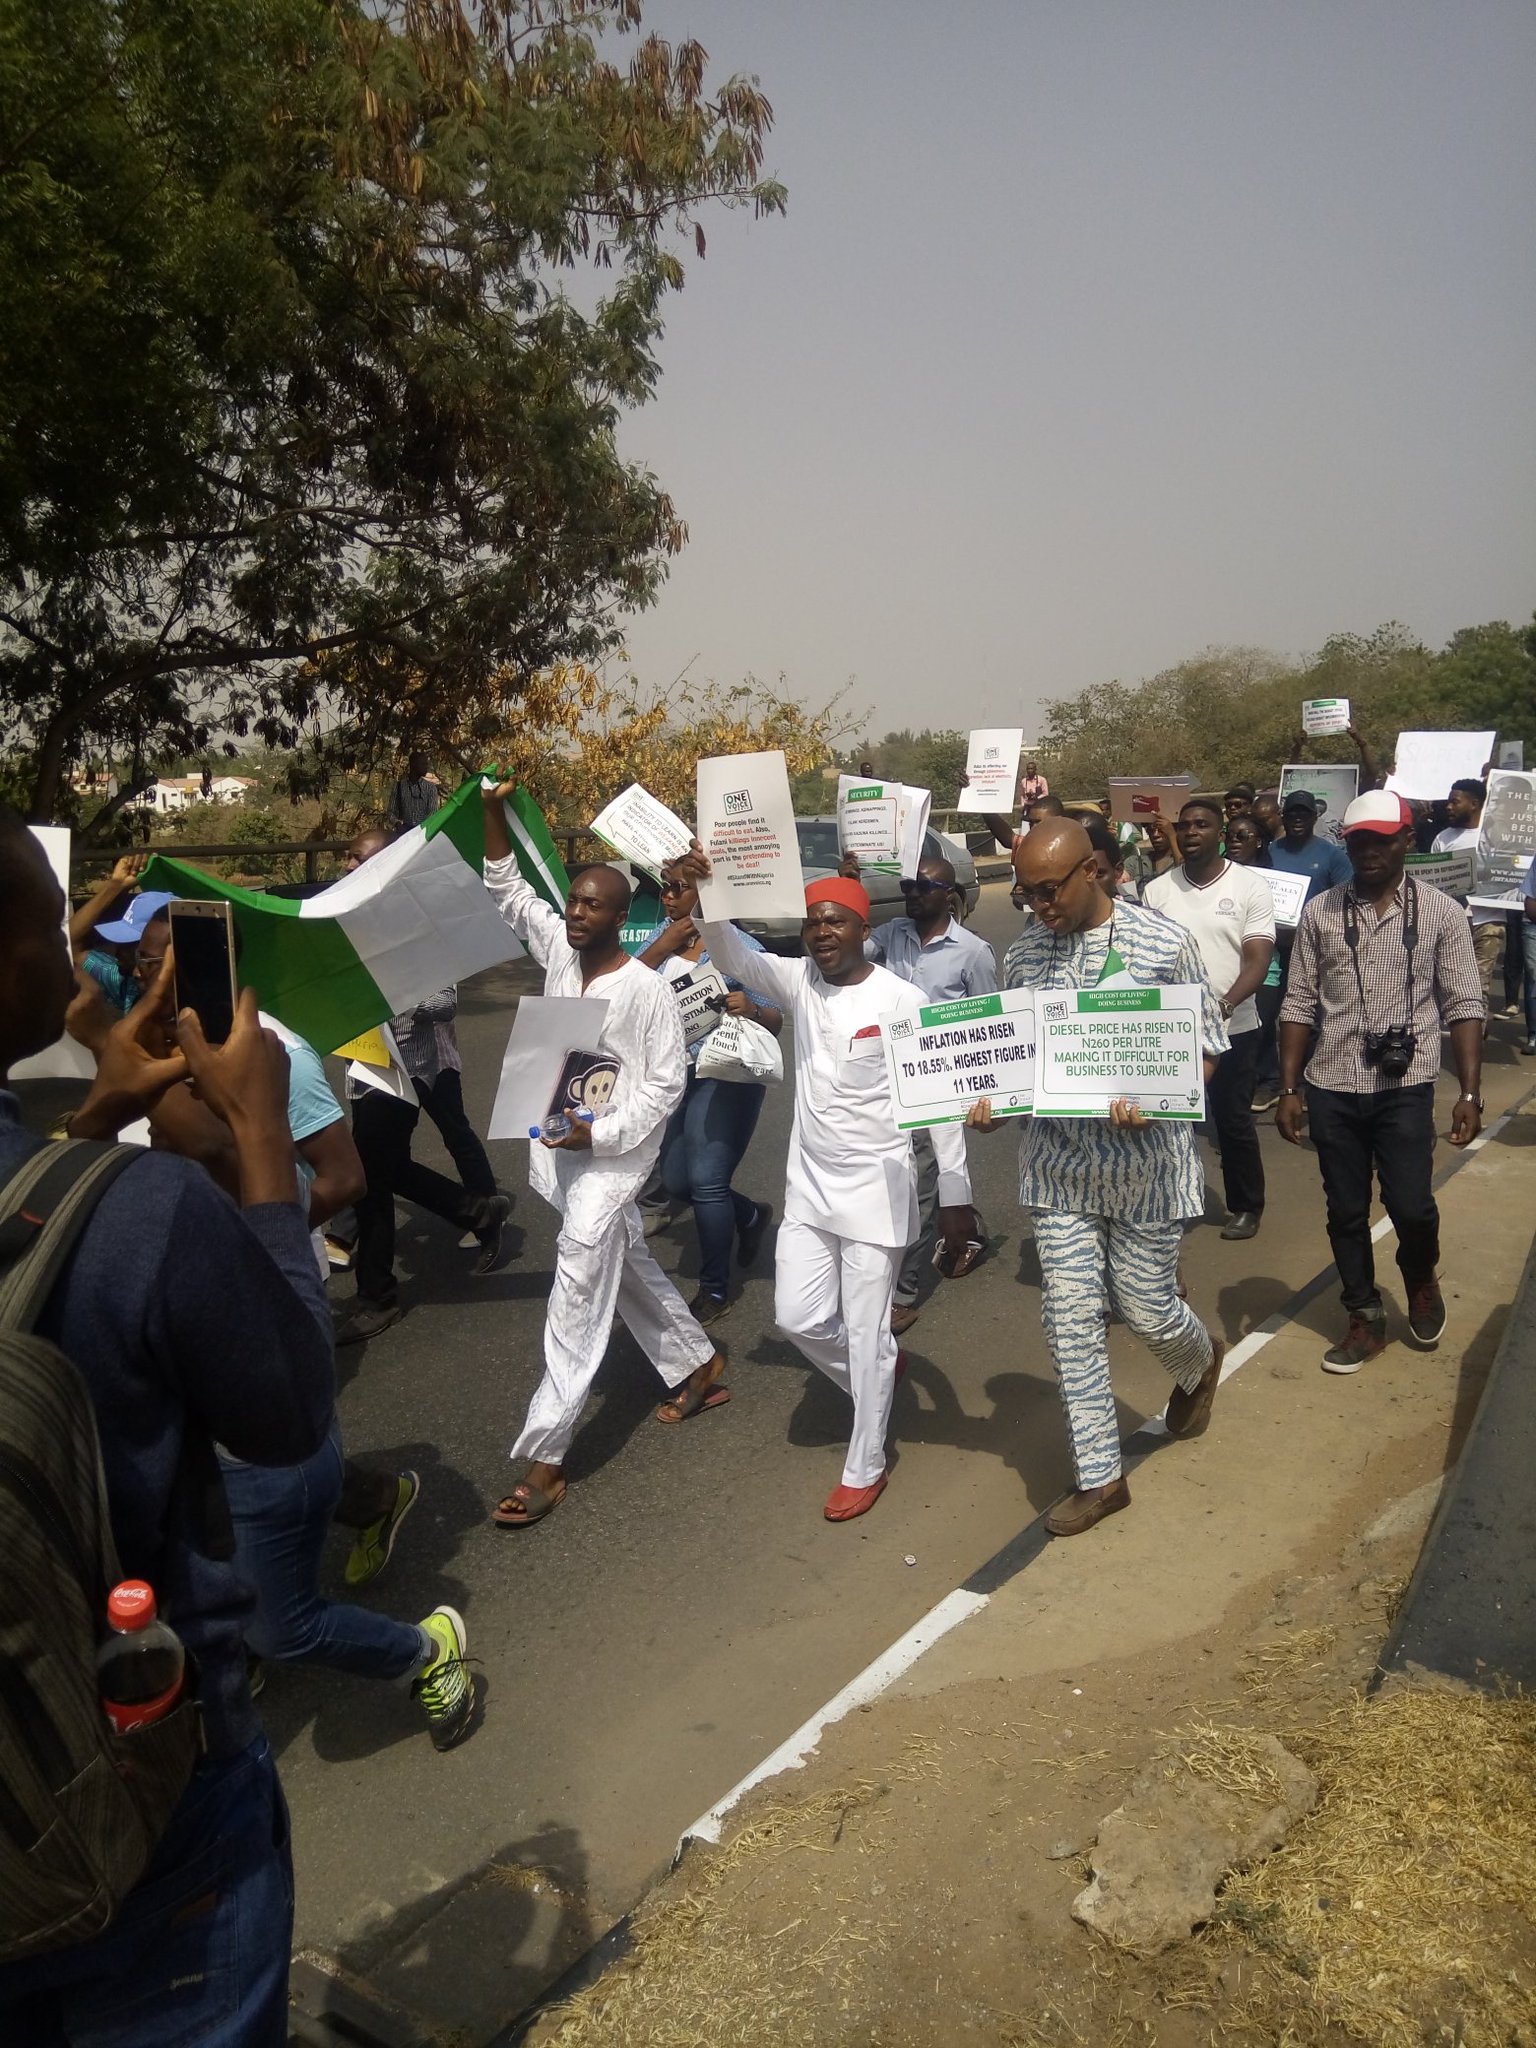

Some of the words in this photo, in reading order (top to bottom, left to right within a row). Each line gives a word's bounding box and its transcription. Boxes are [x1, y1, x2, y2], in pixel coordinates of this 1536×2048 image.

[726, 793, 747, 804] ONE
[850, 790, 878, 799] SECURITY
[1507, 792, 1530, 800] THE
[728, 802, 748, 810] VOICE
[728, 820, 747, 828] people
[661, 824, 678, 840] LEARN
[713, 829, 735, 837] difficult
[710, 839, 727, 847] Fulani
[1501, 834, 1533, 844] WITH
[754, 843, 780, 851] annoying
[713, 856, 725, 864] part
[743, 852, 773, 860] pretending
[969, 999, 987, 1007] LIVING
[960, 1008, 983, 1016] BUSINESS
[1046, 1004, 1064, 1013] ONE
[891, 1022, 909, 1032] ONE
[1050, 1024, 1087, 1036] DIESEL
[1089, 1023, 1119, 1035] PRICE
[1122, 1023, 1142, 1034] HAS
[1145, 1022, 1174, 1034] RISEN
[1177, 1022, 1192, 1033] TO
[919, 1030, 967, 1052] INFLATION
[968, 1026, 988, 1043] HAS
[989, 1022, 1016, 1040] RISEN
[1082, 1038, 1110, 1049] N260
[1113, 1037, 1133, 1048] PER
[1135, 1037, 1162, 1048] LITRE
[902, 1062, 915, 1078] TO
[954, 1050, 992, 1070] HIGHEST
[994, 1045, 1026, 1064] FIGURE
[1028, 1043, 1036, 1059] IN
[1054, 1052, 1099, 1063] MAKING
[1102, 1051, 1112, 1062] IT
[1114, 1050, 1165, 1062] DIFFICULT
[1167, 1051, 1190, 1062] FOR
[1066, 1065, 1117, 1077] BUSINESS
[1120, 1065, 1134, 1076] TO
[1136, 1065, 1179, 1077] SURVIVE
[954, 1078, 964, 1094] 11
[966, 1074, 999, 1092] YEARS.
[113, 1587, 149, 1600] Coca-Cola
